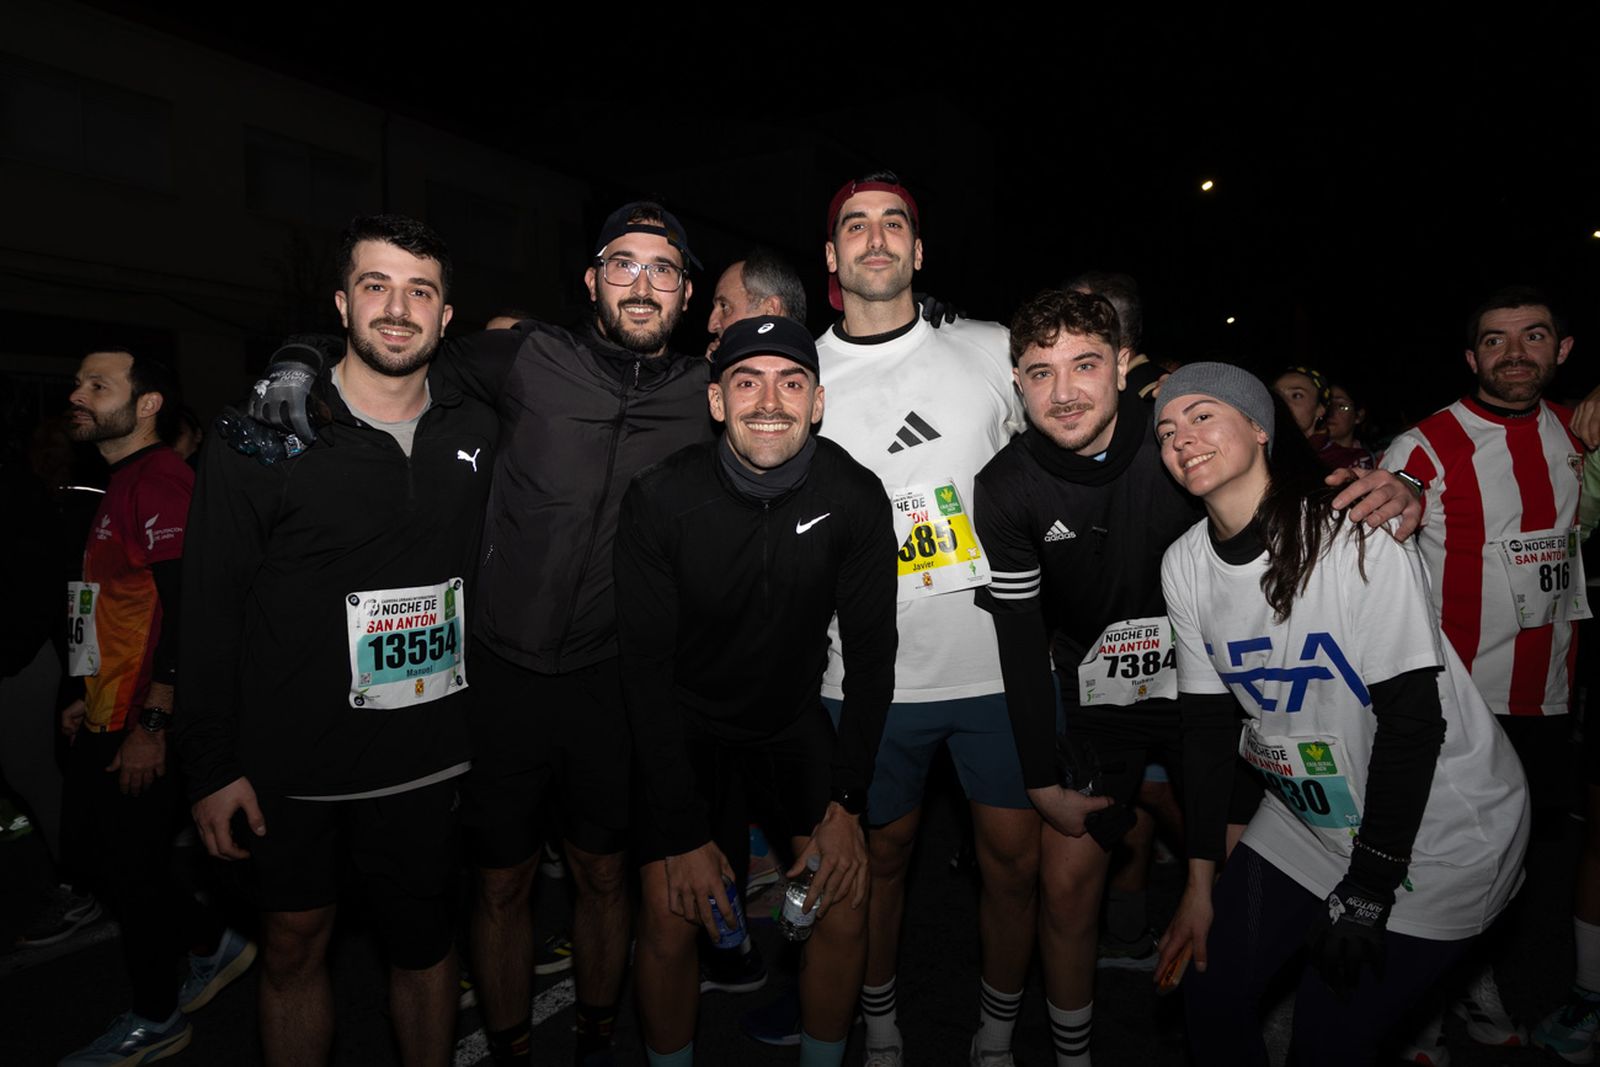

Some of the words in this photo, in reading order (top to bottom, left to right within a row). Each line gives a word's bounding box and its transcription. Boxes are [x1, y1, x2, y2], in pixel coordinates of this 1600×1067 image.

[912, 497, 926, 509] DE
[1044, 530, 1077, 542] adidas
[1524, 540, 1556, 551] NOCHE
[1557, 539, 1566, 548] DE
[912, 560, 934, 571] Javier
[1515, 553, 1538, 565] SAN
[1539, 562, 1570, 593] 816
[382, 601, 422, 615] NOCHE
[424, 599, 438, 611] DE
[367, 618, 393, 633] SAN
[396, 612, 437, 630] ANTÓN
[1105, 629, 1143, 643] NOCHE
[1145, 627, 1160, 637] DE
[368, 622, 457, 671] 13554
[1098, 644, 1116, 654] AN
[1119, 637, 1160, 653] ANTÓN
[1103, 648, 1177, 679] 7384
[406, 665, 433, 677] Manuel
[1272, 750, 1288, 760] DE
